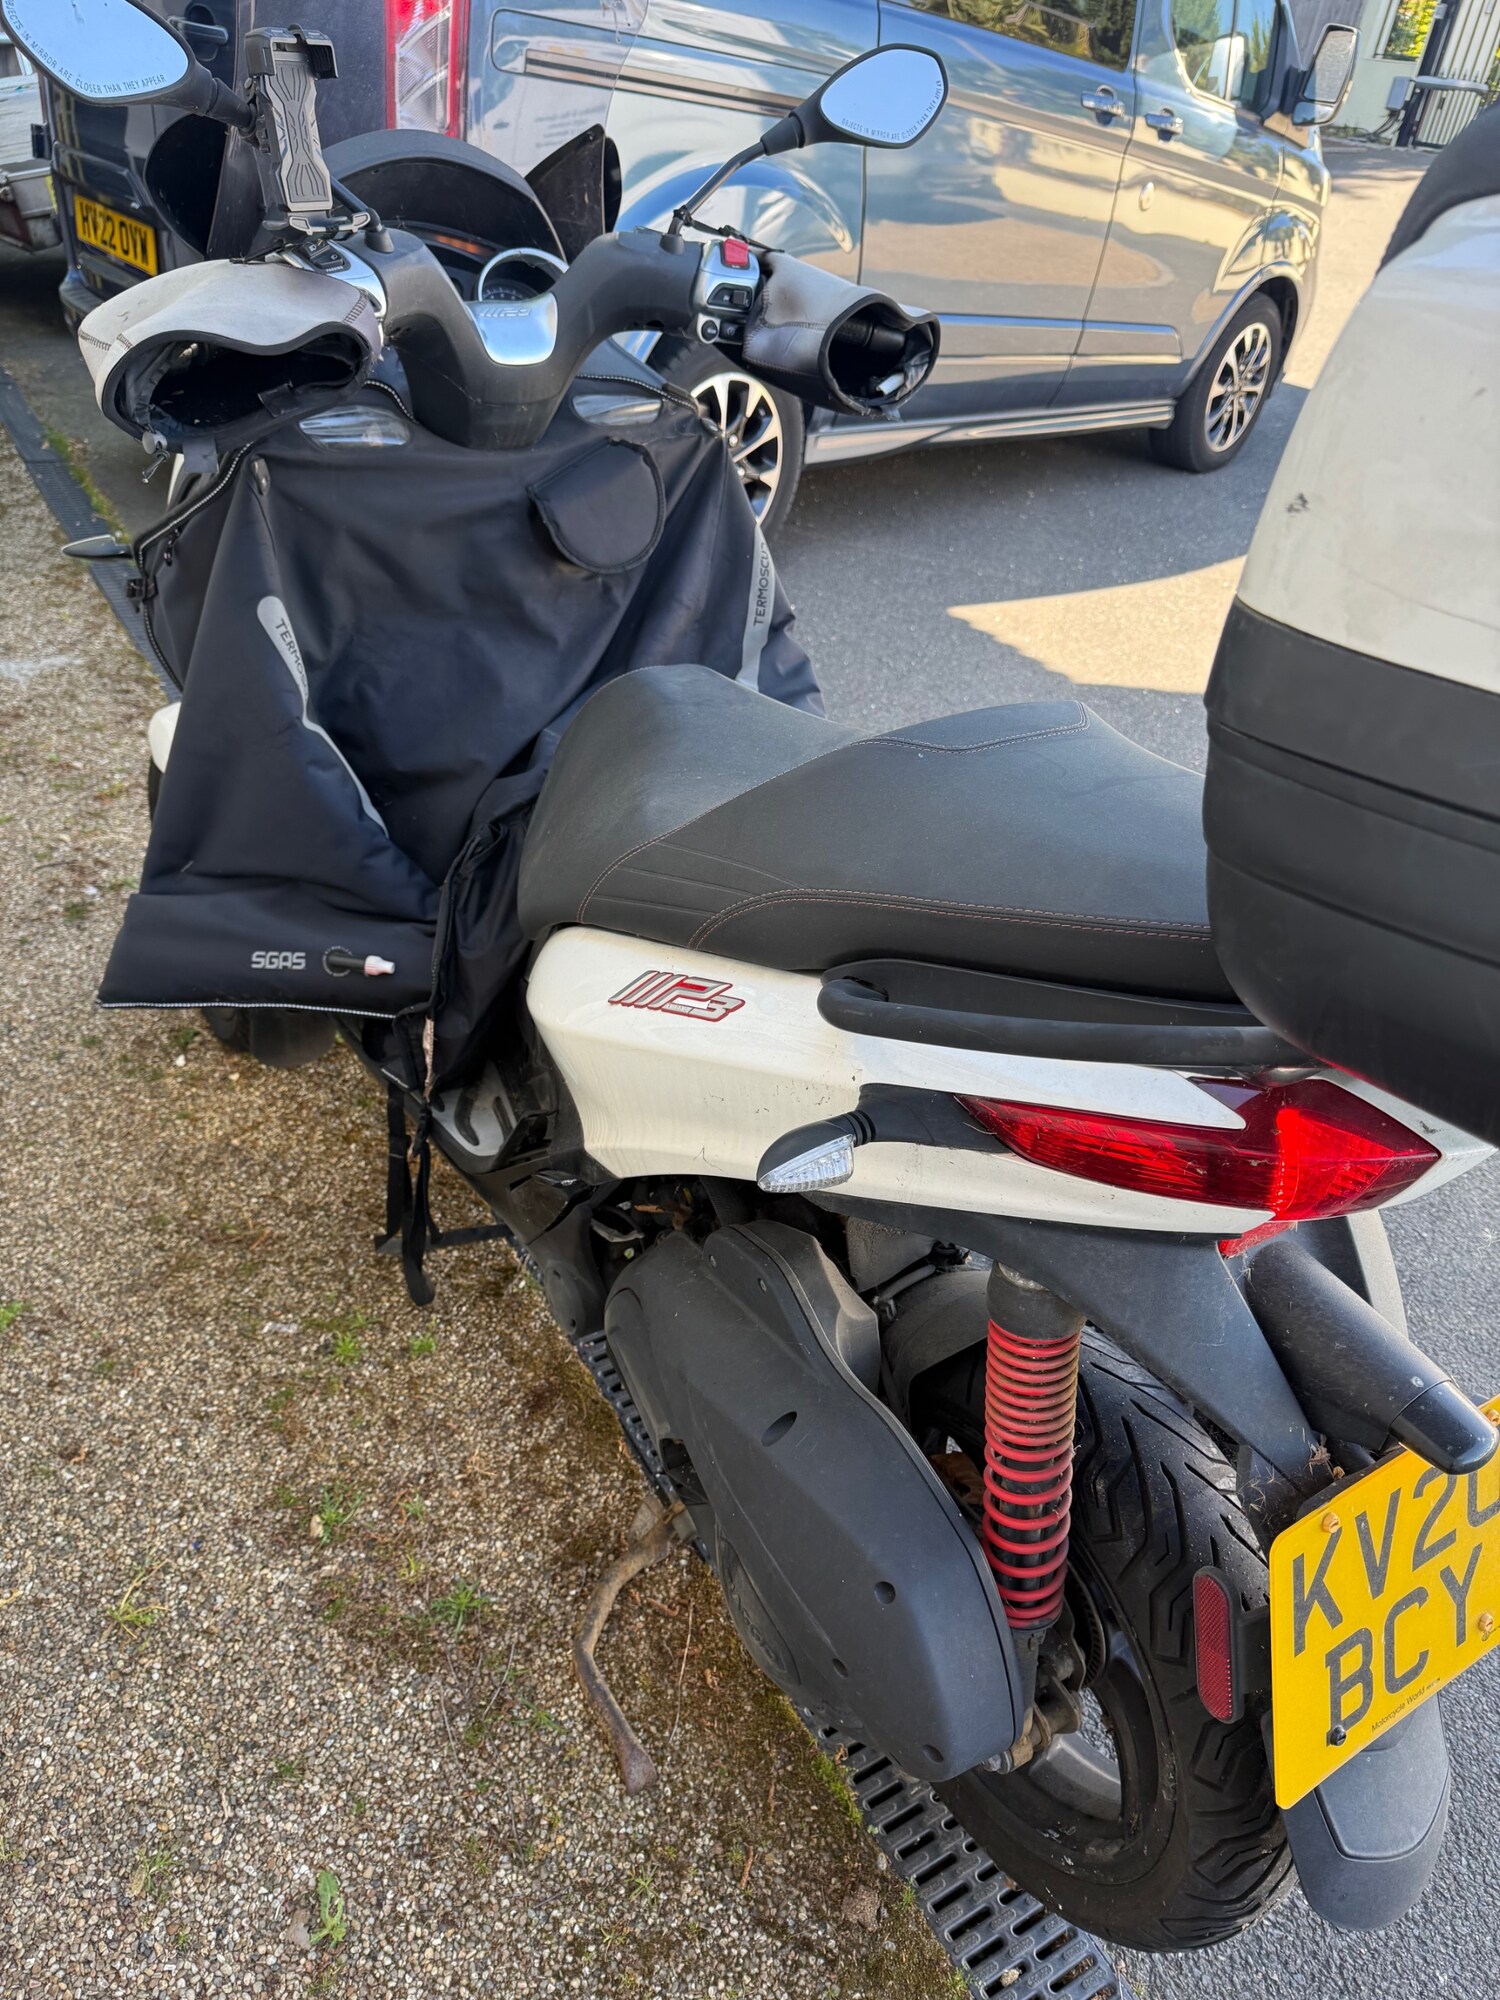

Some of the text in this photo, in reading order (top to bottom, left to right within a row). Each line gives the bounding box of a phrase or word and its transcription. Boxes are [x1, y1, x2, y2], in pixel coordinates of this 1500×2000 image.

[5, 0, 166, 94] BJECTS IN MIRROR ARE CLOSER THAN THEY APPEAR
[841, 117, 863, 132] OBJECTS
[871, 127, 890, 139] MIRROR
[890, 133, 900, 141] ARE
[917, 113, 929, 126] THAN
[926, 100, 937, 113] THEY
[251, 951, 306, 970] SGAS
[1324, 1542, 1483, 1747] BCY
[1371, 1686, 1425, 1732] Motorcycle World
